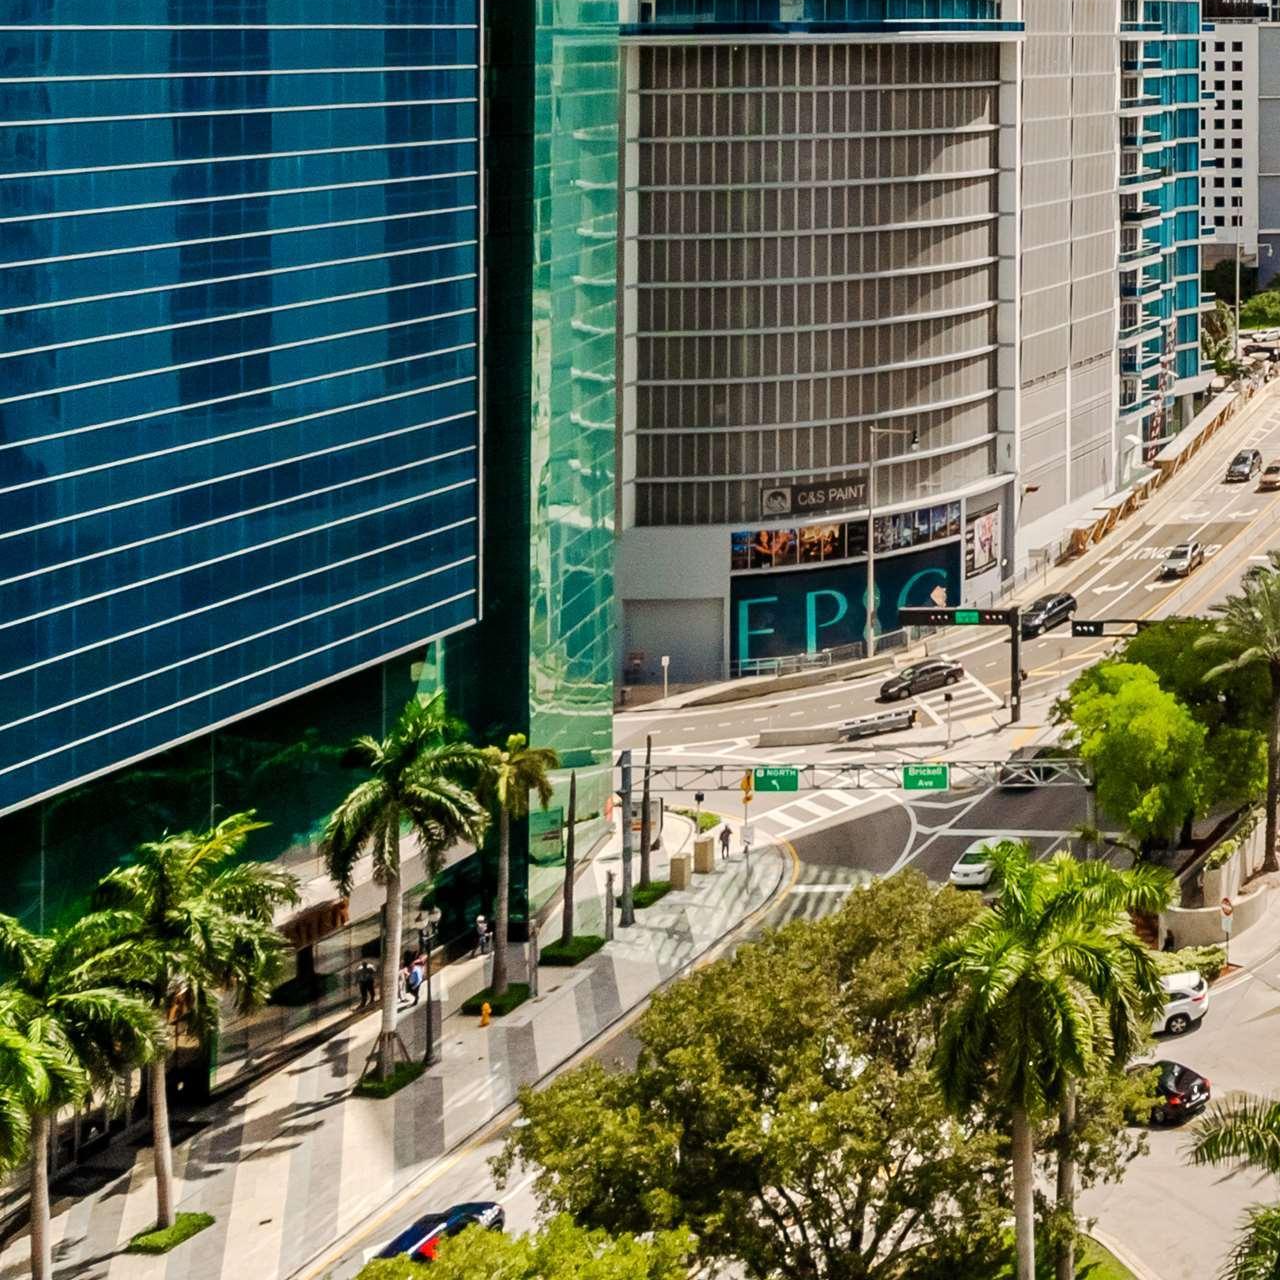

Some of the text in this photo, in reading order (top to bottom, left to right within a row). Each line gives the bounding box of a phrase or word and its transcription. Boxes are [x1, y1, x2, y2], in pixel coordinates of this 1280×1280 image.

[766, 768, 797, 777] NORTH
[908, 766, 943, 777] Brickell
[917, 779, 934, 787] Ave
